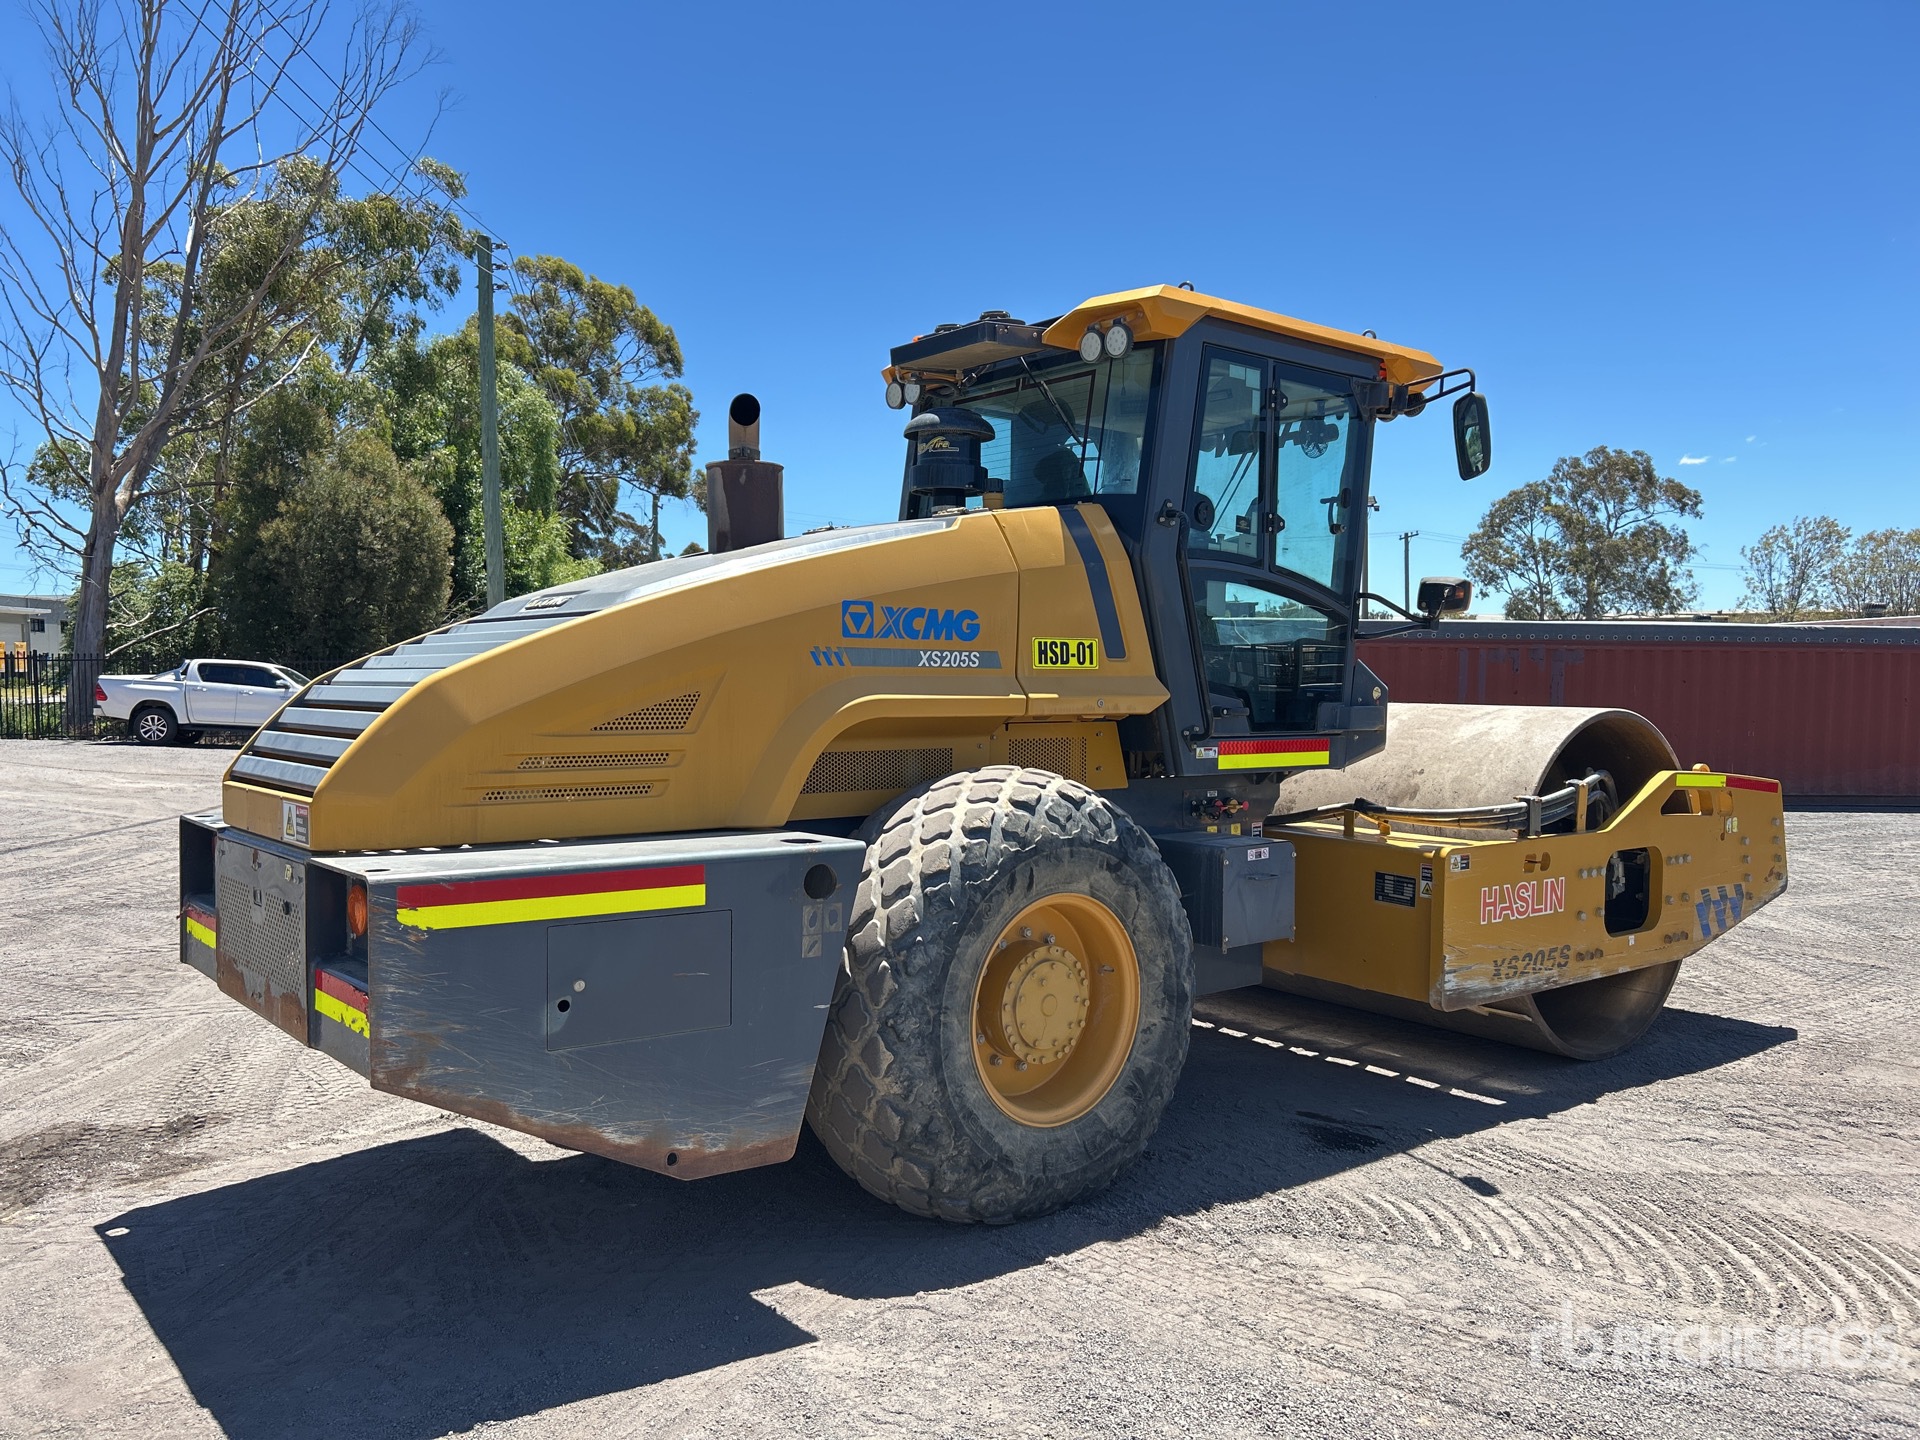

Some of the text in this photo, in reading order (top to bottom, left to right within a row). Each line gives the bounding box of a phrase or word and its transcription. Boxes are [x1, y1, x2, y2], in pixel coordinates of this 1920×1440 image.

[874, 605, 981, 641] XCMG
[918, 650, 980, 668] XS205S
[1037, 640, 1095, 666] HSD-01
[1480, 876, 1566, 925] HASLIN
[1492, 944, 1572, 980] XS205S
